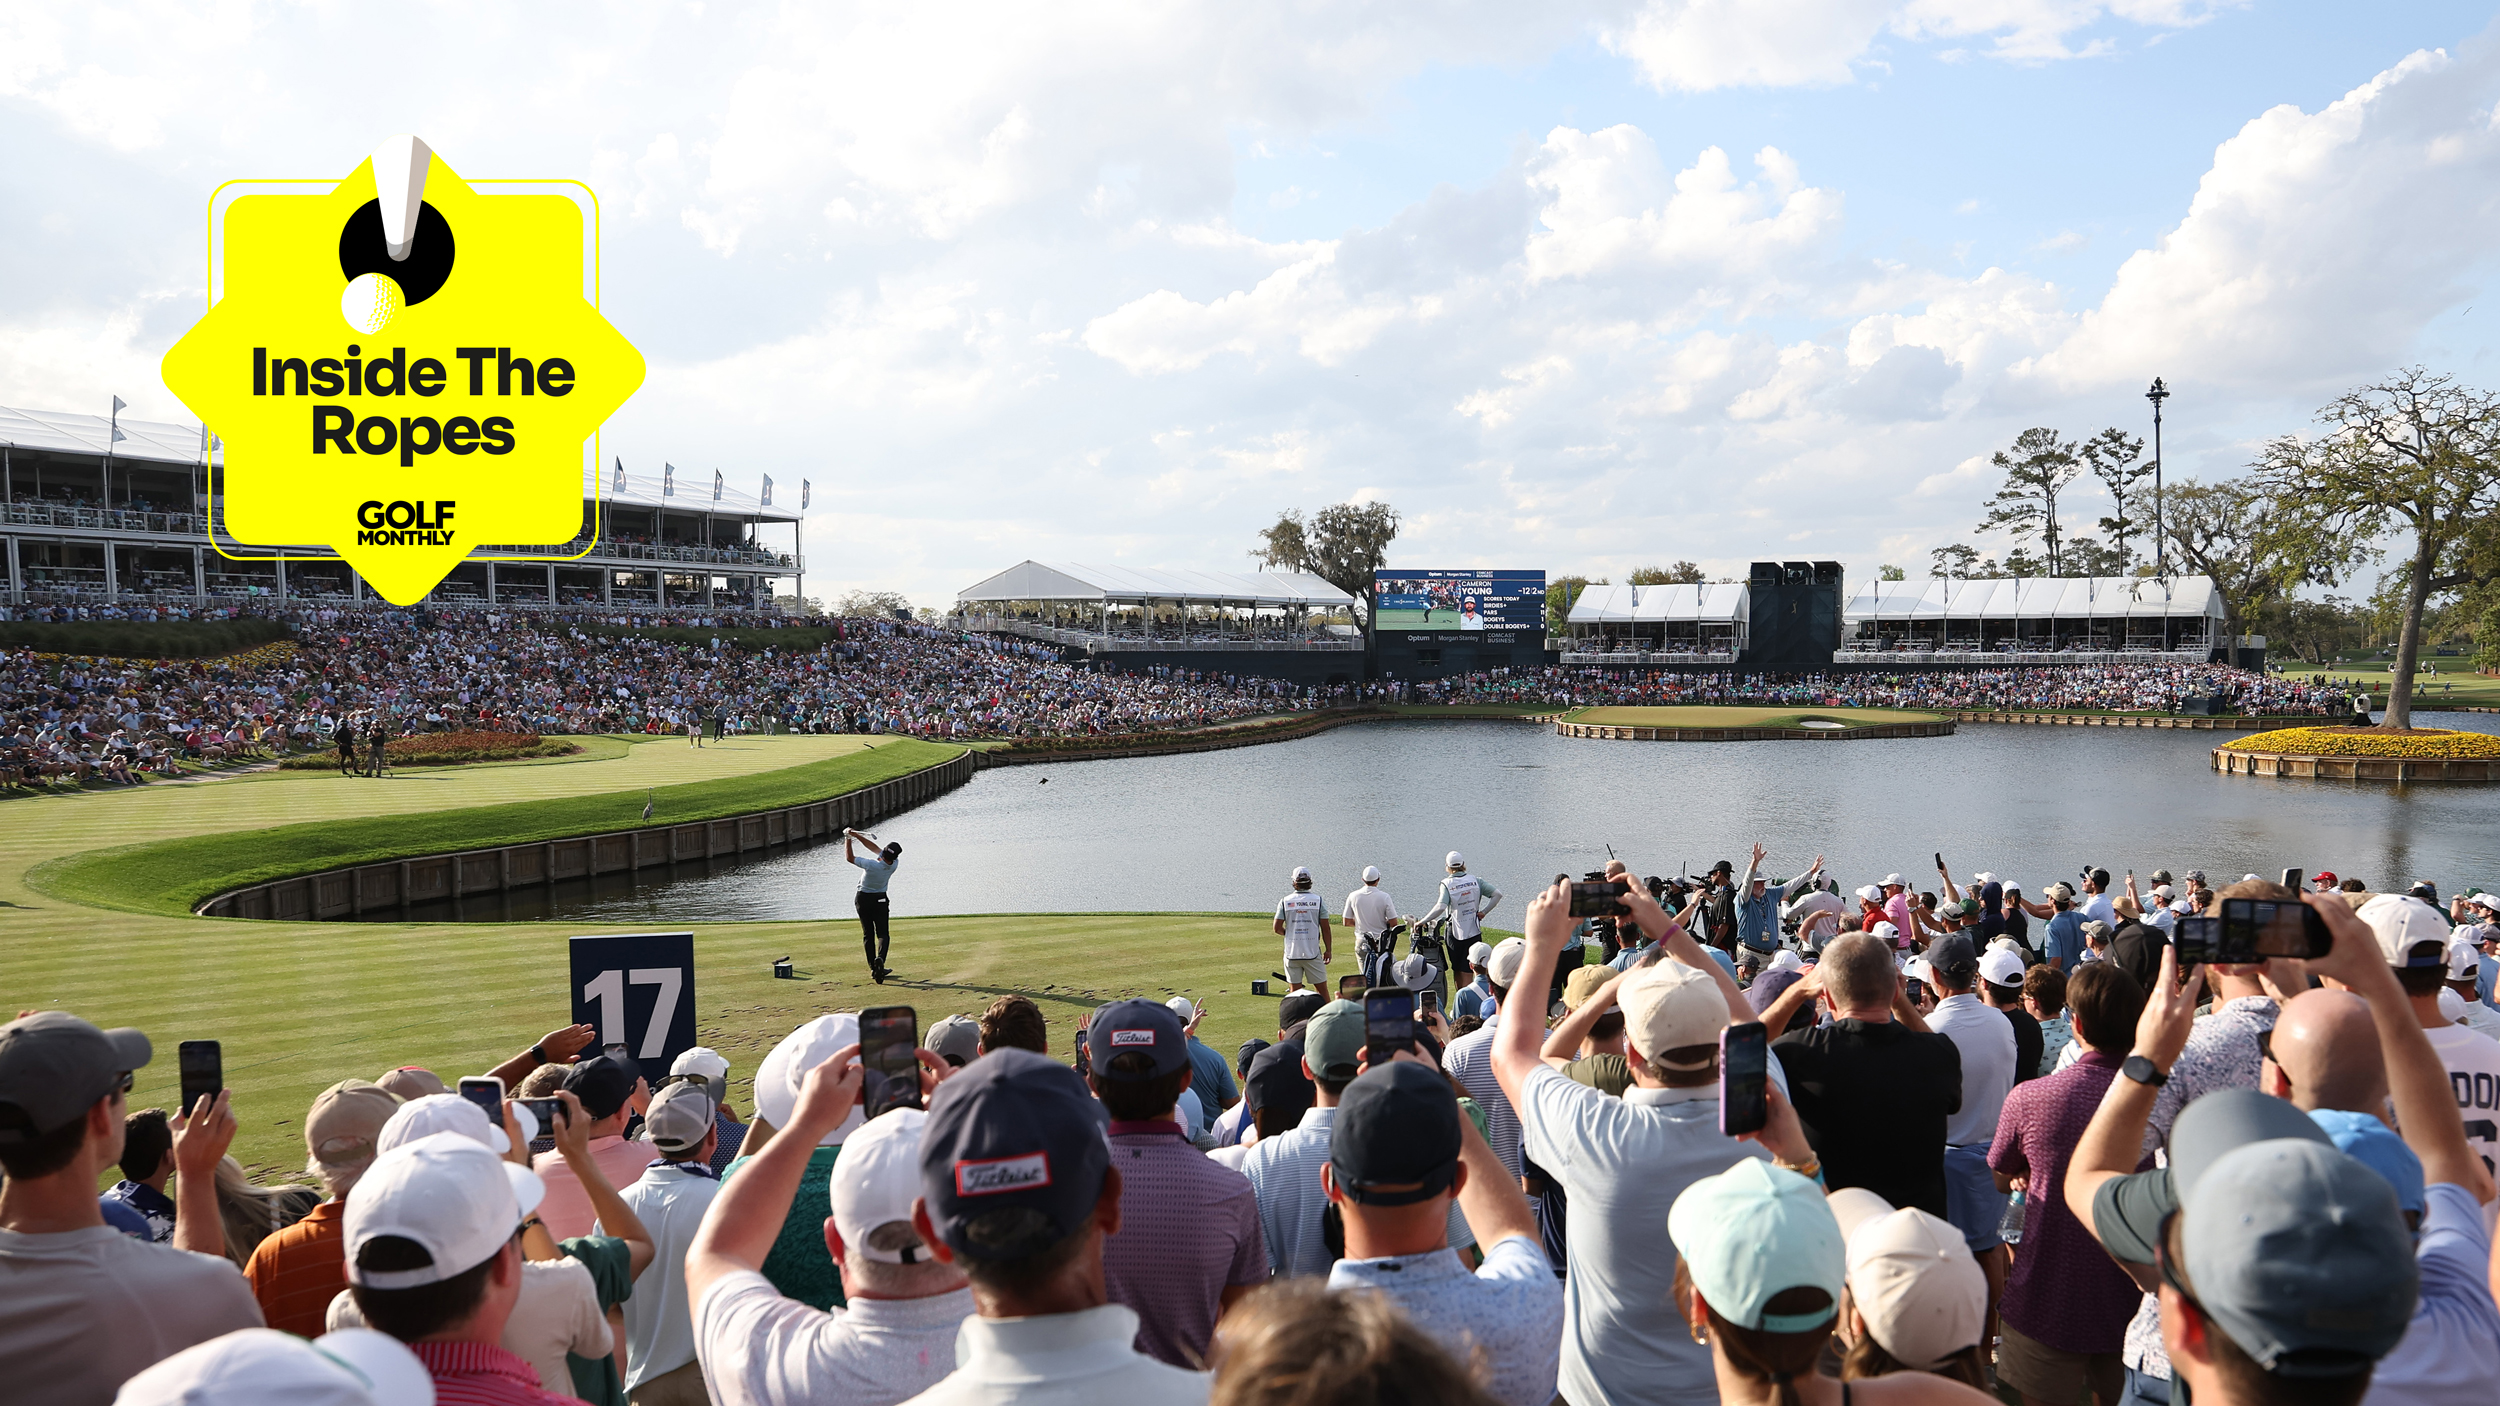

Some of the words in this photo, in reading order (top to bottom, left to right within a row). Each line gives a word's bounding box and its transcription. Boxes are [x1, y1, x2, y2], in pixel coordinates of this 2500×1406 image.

[1461, 587, 1493, 595] YOUNG
[1407, 635, 1430, 643] Optum
[1438, 635, 1458, 643] Morgan
[1458, 635, 1479, 643] Stanley
[584, 967, 683, 1060] 17
[1115, 1031, 1152, 1045] Titleist
[967, 1163, 1042, 1188] Titleist
